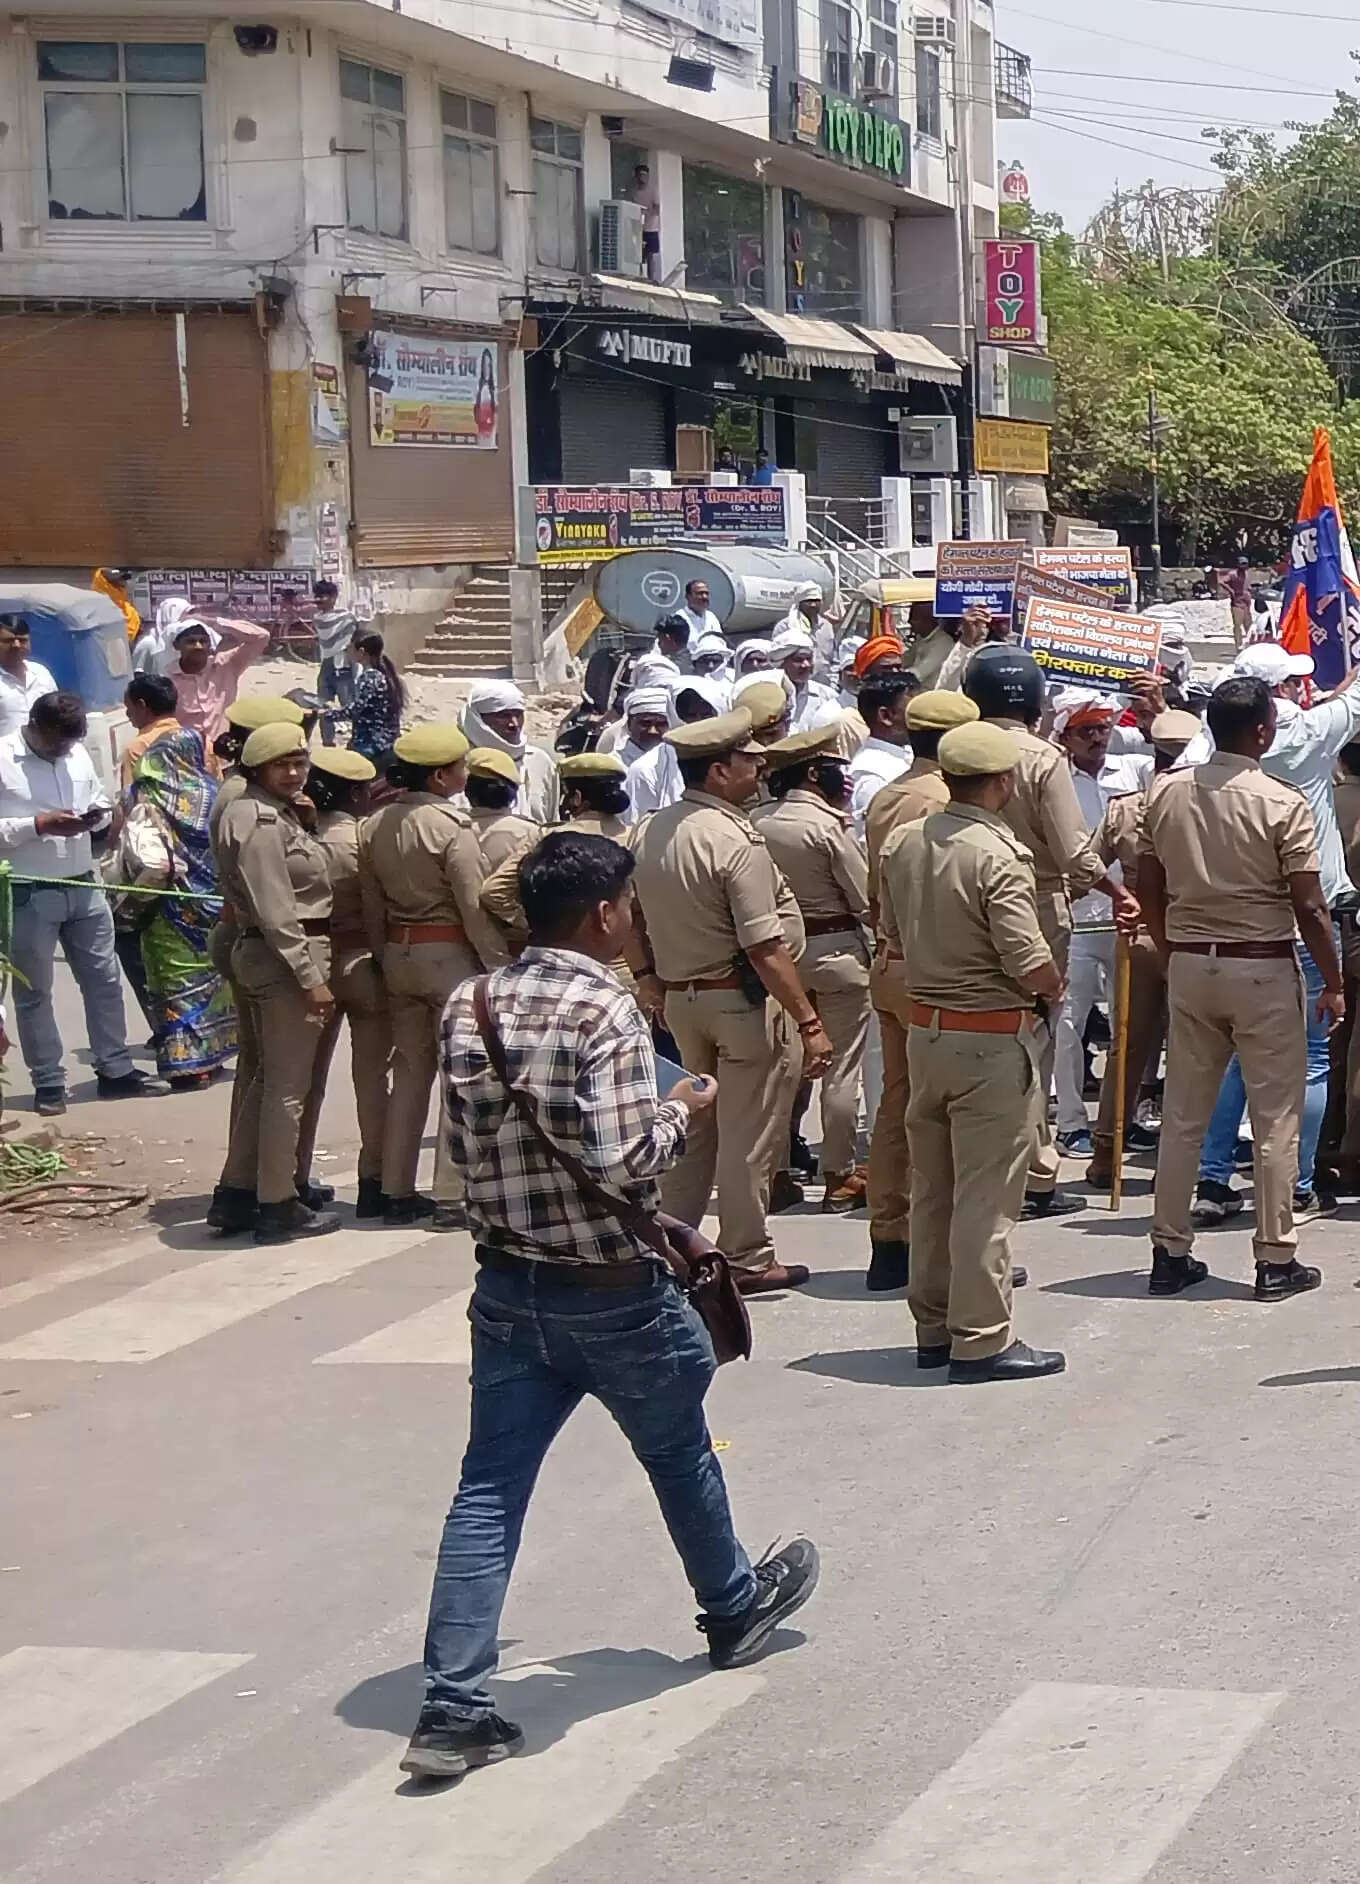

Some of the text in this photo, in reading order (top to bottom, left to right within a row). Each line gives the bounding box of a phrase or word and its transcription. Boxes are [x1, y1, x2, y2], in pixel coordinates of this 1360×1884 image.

[825, 102, 904, 176] TOY DEPO
[995, 243, 1024, 326] TOY
[989, 327, 1031, 340] SHOP
[630, 335, 692, 368] MUFTI
[555, 522, 607, 539] VINAYAKA
[1071, 612, 1098, 626] पटेल
[1100, 616, 1113, 629] के
[1032, 649, 1105, 677] गिरफ्तार
[1053, 642, 1098, 657] भाजपा
[1100, 646, 1127, 662] नेता
[1129, 653, 1149, 666] को
